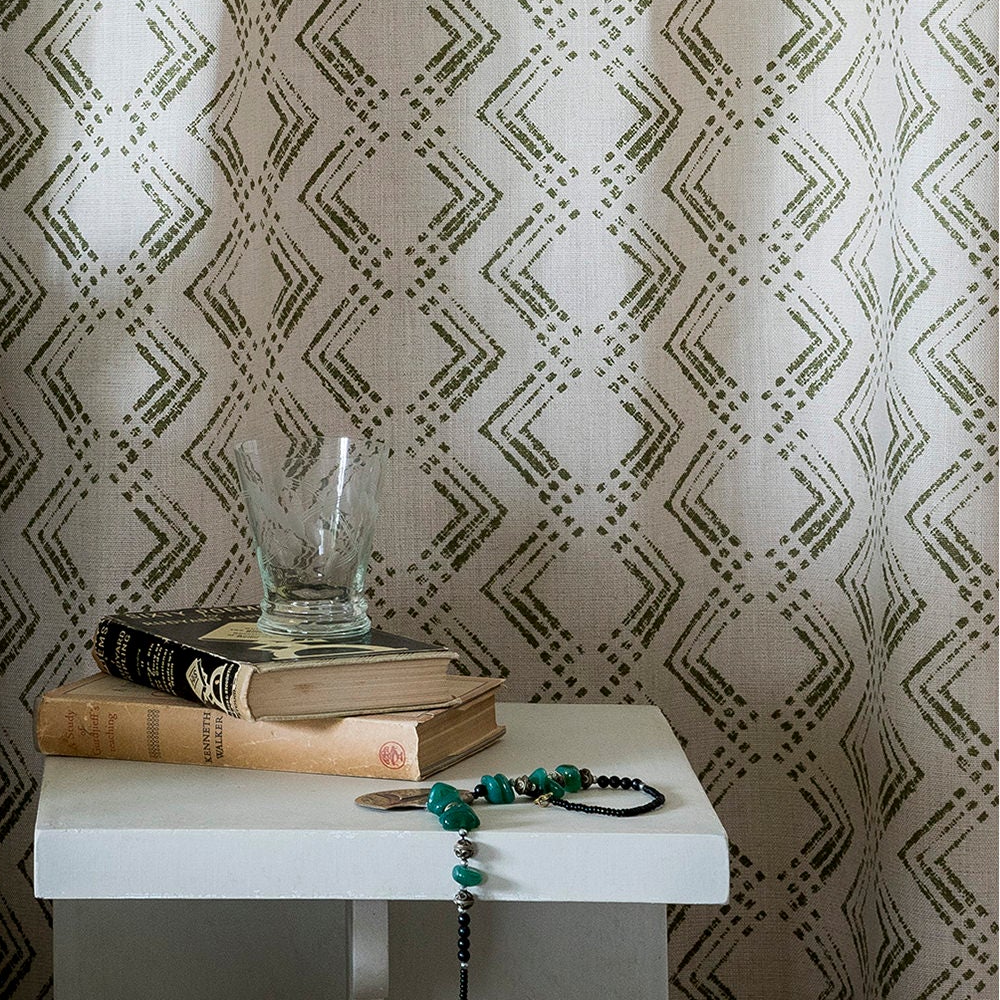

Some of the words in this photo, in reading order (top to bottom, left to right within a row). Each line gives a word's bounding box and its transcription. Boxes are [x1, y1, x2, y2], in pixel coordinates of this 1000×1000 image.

[65, 709, 78, 739] Study
[78, 725, 90, 736] of
[89, 705, 102, 756] Gurdjieff's
[202, 712, 213, 763] KENNETH
[214, 716, 225, 760] WALKER
